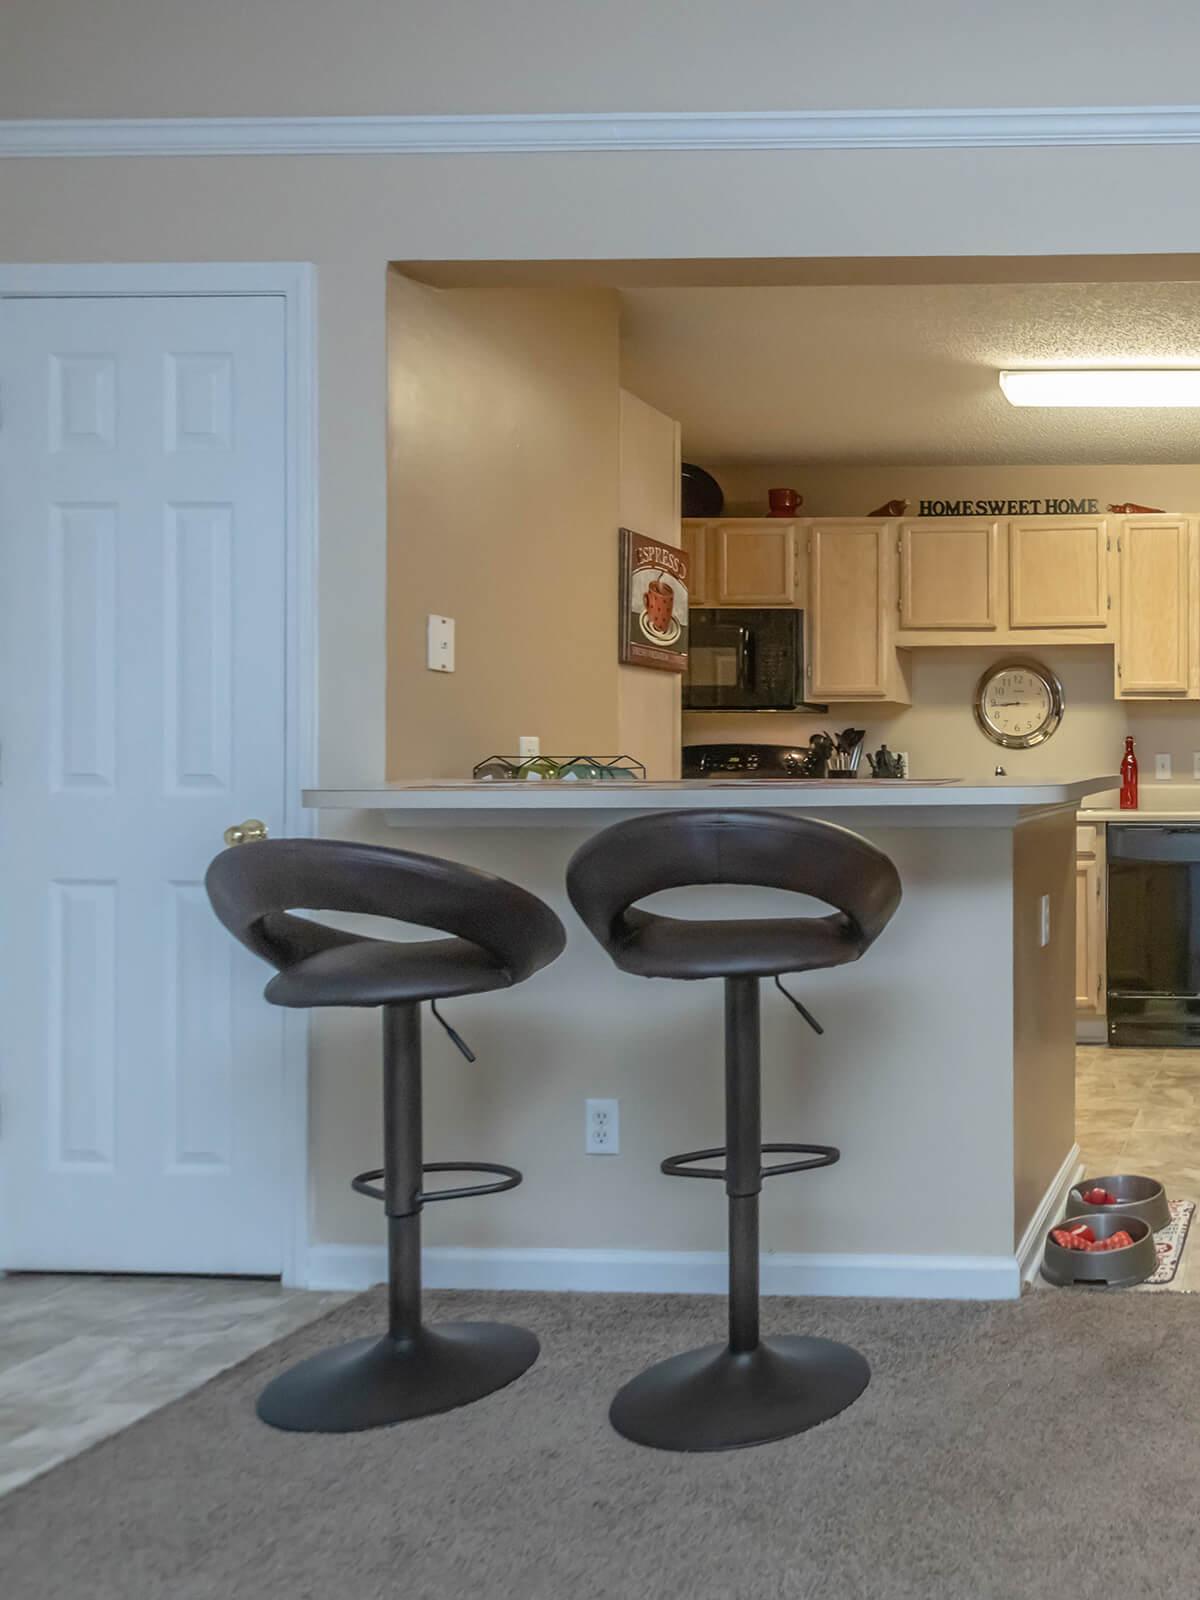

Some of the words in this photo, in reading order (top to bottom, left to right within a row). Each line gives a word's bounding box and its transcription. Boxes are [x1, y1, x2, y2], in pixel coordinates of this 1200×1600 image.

[919, 500, 973, 516] HOME
[975, 499, 1041, 515] SWEET
[1045, 498, 1100, 514] HOME
[635, 546, 687, 579] ESPRESSO
